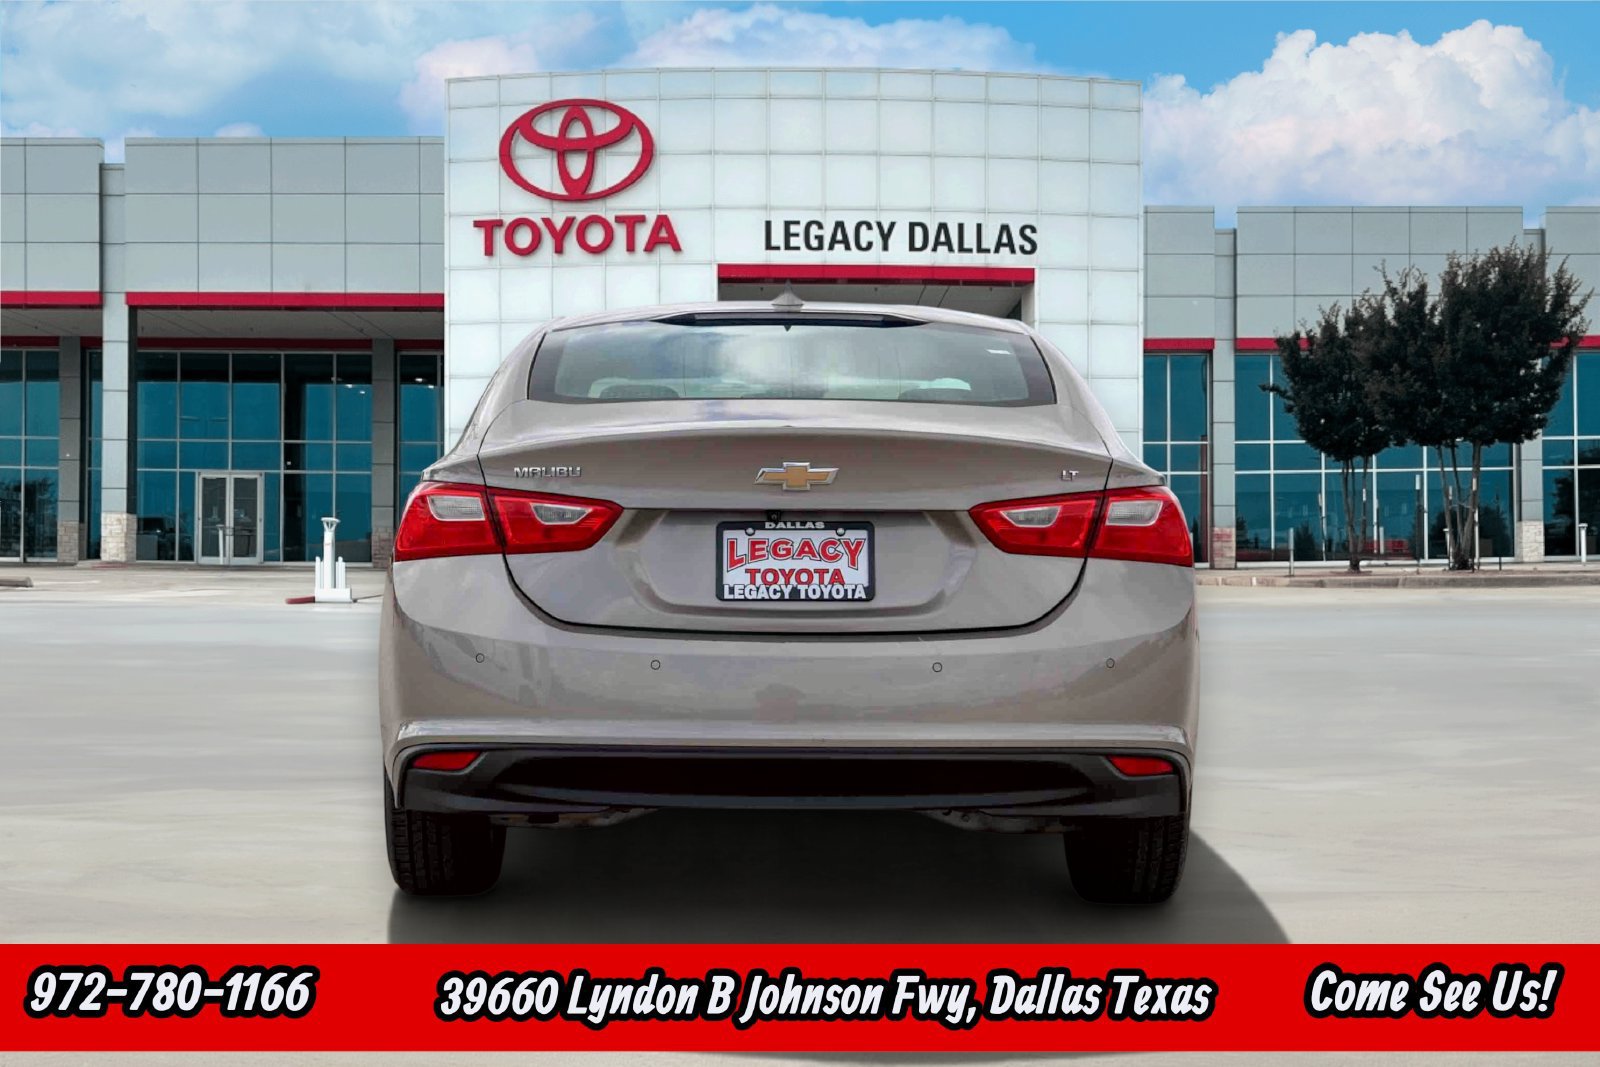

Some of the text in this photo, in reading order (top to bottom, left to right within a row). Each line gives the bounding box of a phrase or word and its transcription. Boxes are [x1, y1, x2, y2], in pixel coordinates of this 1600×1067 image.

[474, 214, 681, 256] TOYOTA
[764, 219, 1039, 256] LEGACY DALLAS
[513, 465, 582, 478] MALIBU
[1061, 469, 1079, 481] LT
[764, 521, 826, 530] DALLAS
[727, 537, 867, 572] LEGACY
[744, 568, 846, 587] TOYOTA
[723, 584, 867, 600] LEGACY TOYOTA
